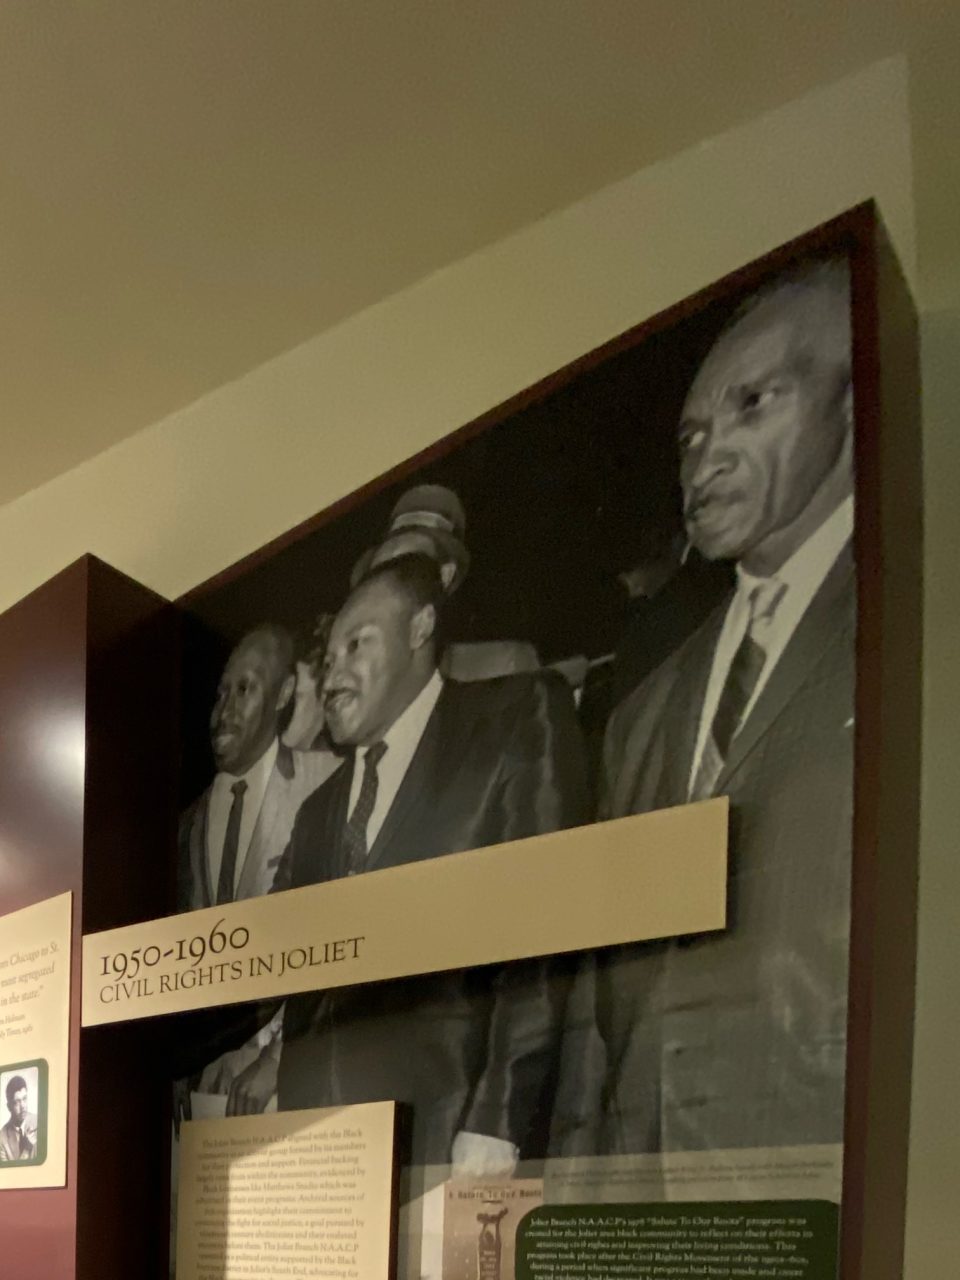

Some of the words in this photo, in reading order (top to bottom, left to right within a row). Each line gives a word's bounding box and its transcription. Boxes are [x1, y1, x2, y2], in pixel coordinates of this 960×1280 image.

[100, 918, 250, 981] 1950-1960
[100, 978, 154, 1003] CIVIL
[159, 961, 242, 994] RIGHTS
[249, 954, 273, 977] IN
[278, 937, 365, 976] JOLIET
